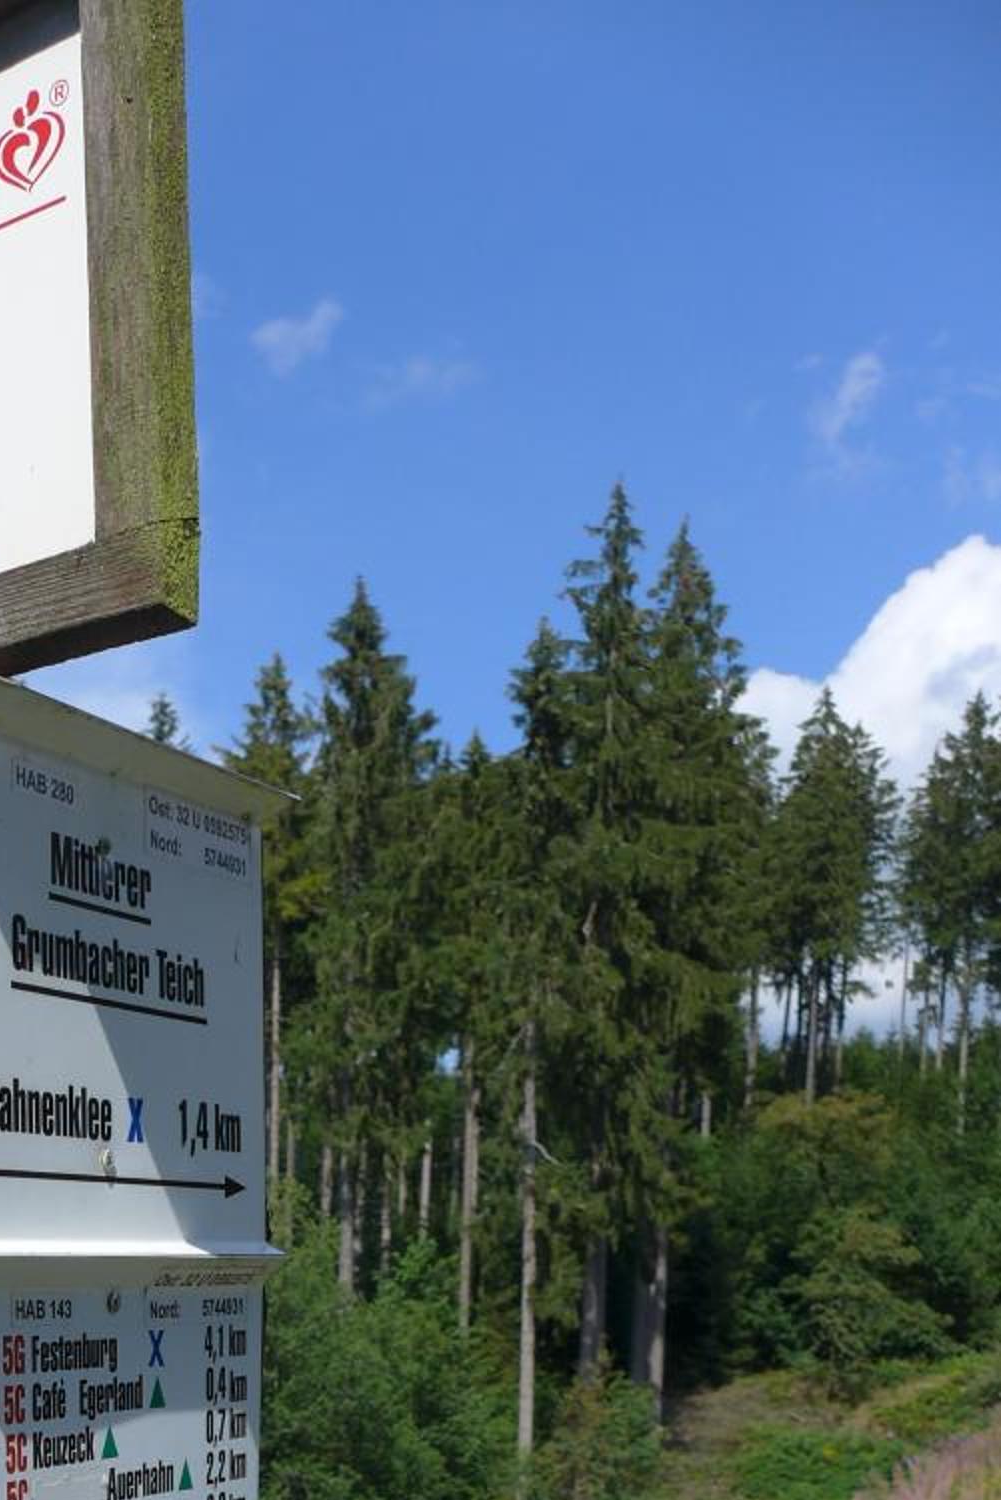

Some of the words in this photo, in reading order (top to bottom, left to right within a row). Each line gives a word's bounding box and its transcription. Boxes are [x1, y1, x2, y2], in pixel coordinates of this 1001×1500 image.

[16, 765, 47, 794] HAB
[177, 806, 189, 825] 32
[193, 811, 200, 829] U
[151, 830, 182, 856] Nord:
[12, 914, 149, 995] Grumbacher
[156, 949, 204, 1007] Teich
[179, 1099, 208, 1157] 1,4
[215, 1104, 241, 1152] km
[16, 1299, 45, 1320] HAB
[51, 1299, 71, 1319] 143
[151, 1300, 180, 1318] Nord:
[3, 1335, 25, 1374] 5G
[32, 1332, 117, 1372] Festenburg
[205, 1325, 225, 1362] 4,1
[229, 1324, 246, 1356] km
[4, 1384, 25, 1424] 5C
[32, 1379, 66, 1421] Café
[79, 1375, 143, 1419] Egerland
[206, 1367, 226, 1402] 0,4
[230, 1373, 247, 1402] km
[6, 1432, 27, 1474] 5C
[33, 1427, 94, 1470] Keuzeck
[206, 1409, 226, 1443] 0,7
[229, 1407, 246, 1439] km
[206, 1450, 226, 1487] 2,2
[230, 1450, 246, 1481] km
